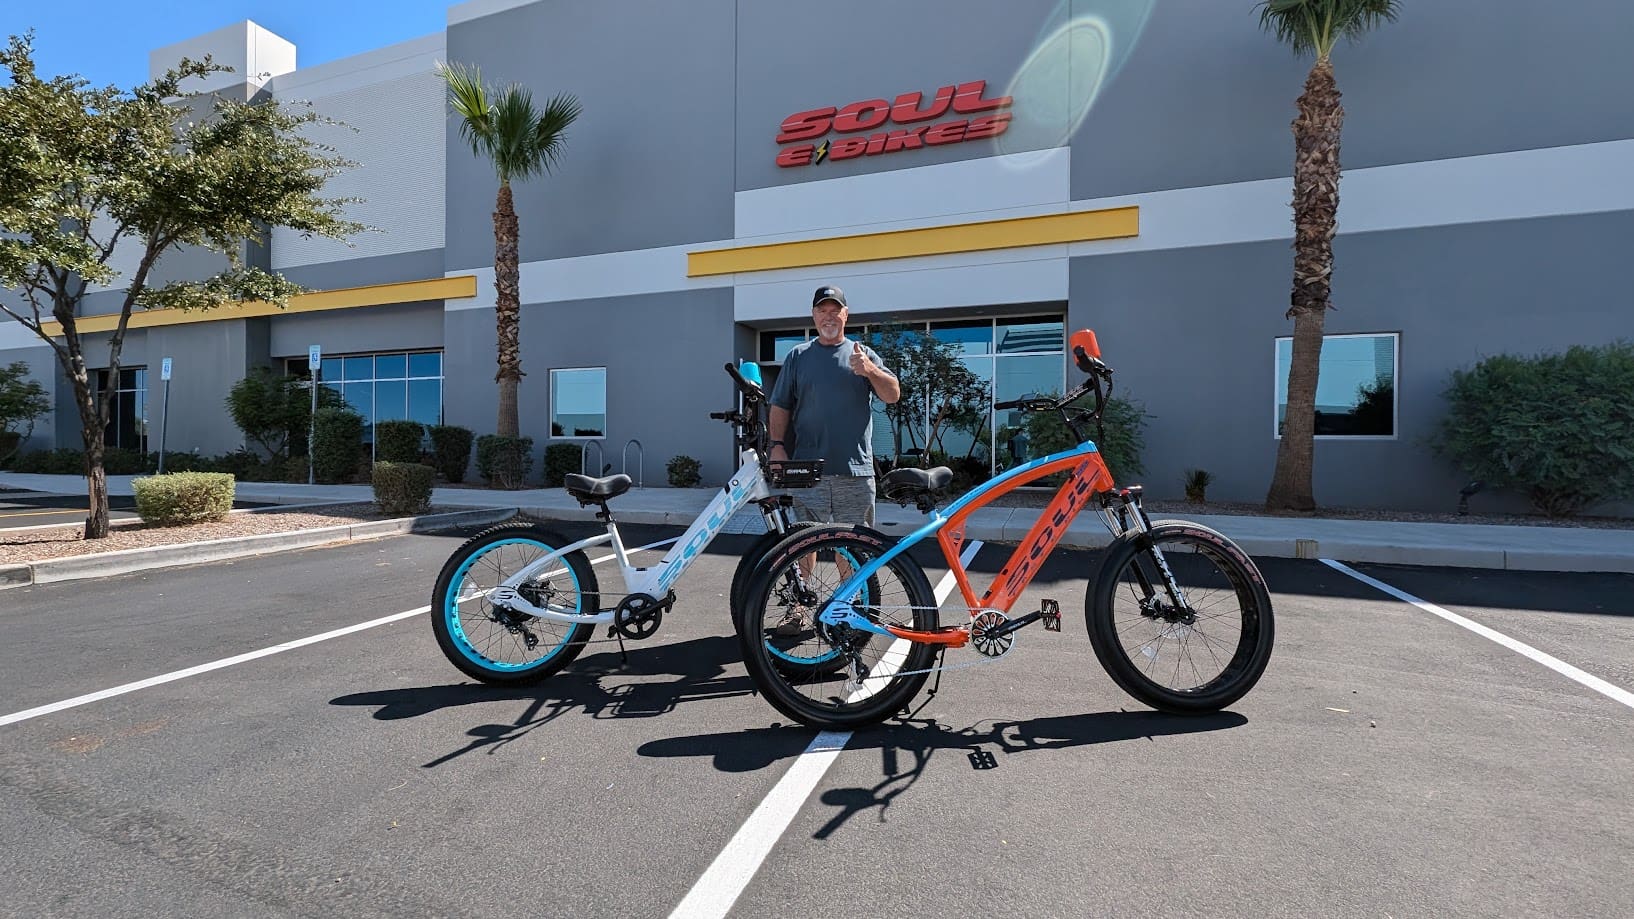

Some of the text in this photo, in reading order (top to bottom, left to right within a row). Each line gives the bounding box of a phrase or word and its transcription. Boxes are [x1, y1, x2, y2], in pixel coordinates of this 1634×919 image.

[776, 80, 1012, 144] SOUL
[829, 112, 1012, 161] BIKES
[658, 476, 757, 592] SOUL
[1006, 469, 1099, 597] SOUL
